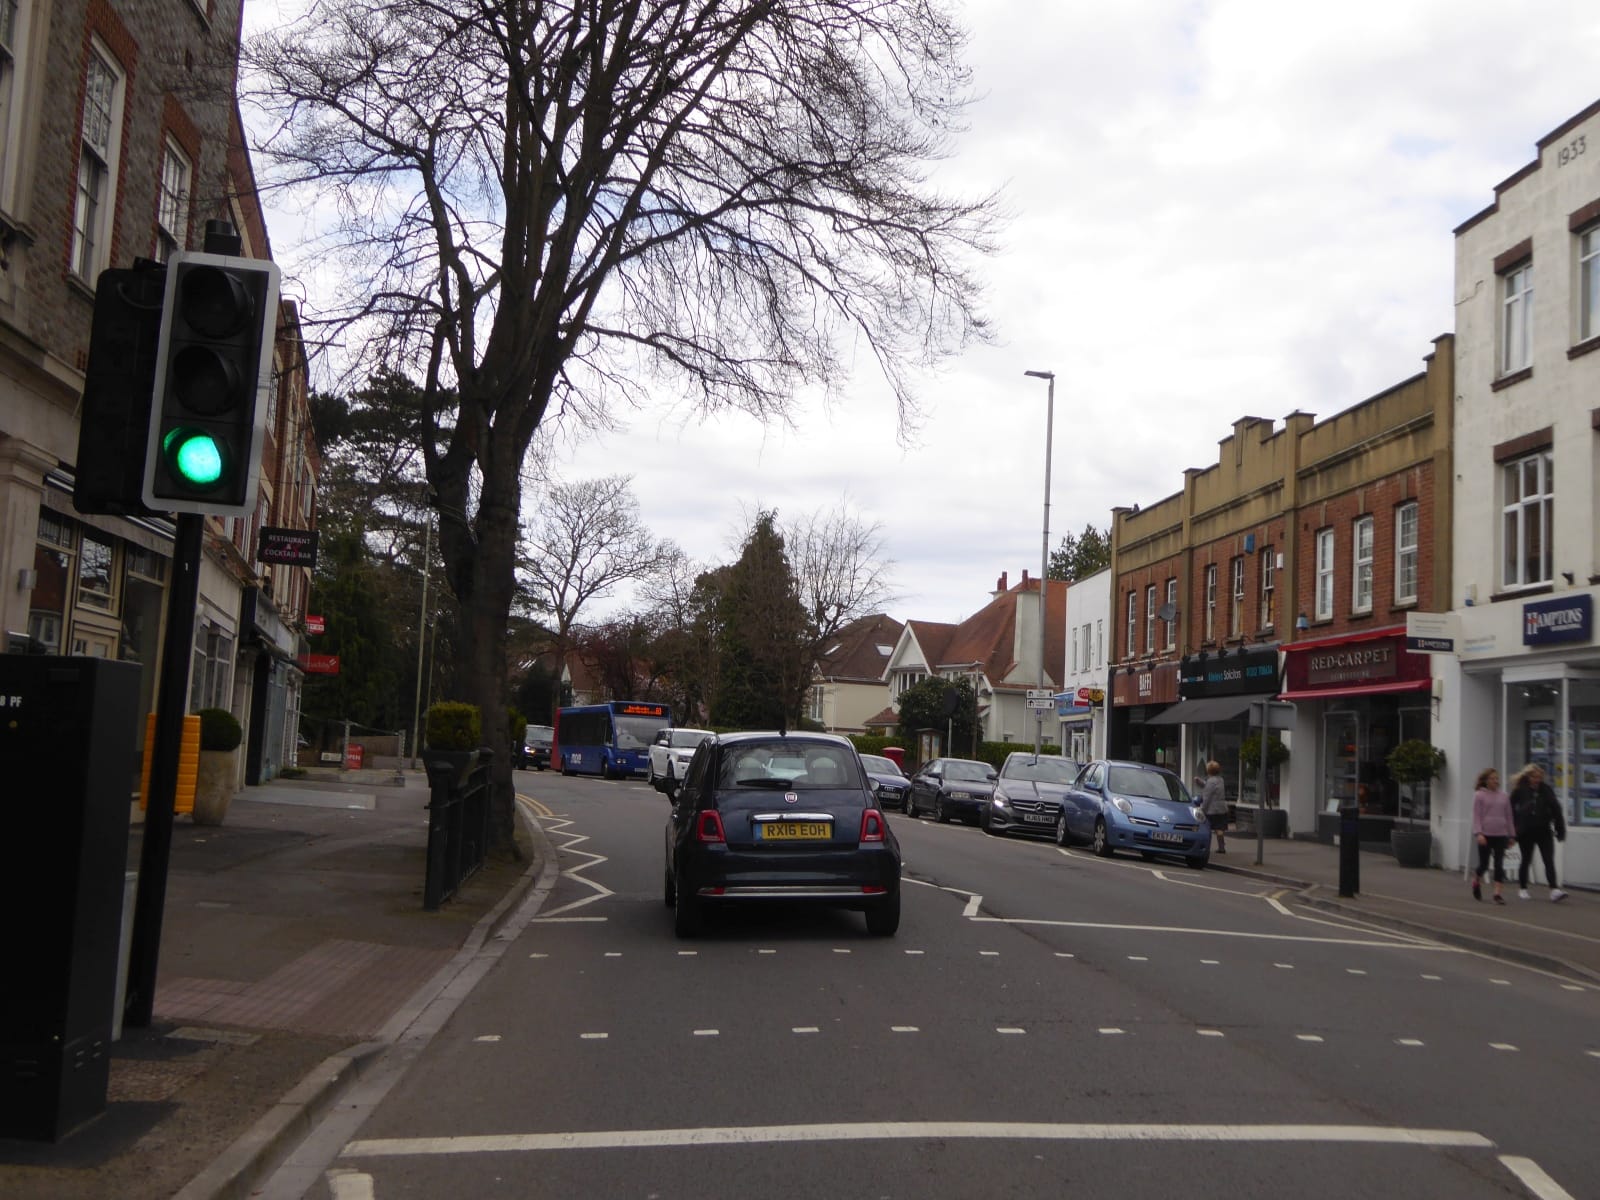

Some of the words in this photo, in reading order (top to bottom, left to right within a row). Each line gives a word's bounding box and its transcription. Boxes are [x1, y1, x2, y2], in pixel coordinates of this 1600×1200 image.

[1557, 135, 1587, 169] 1933
[268, 534, 311, 545] RESTAURANT
[264, 548, 297, 559] COCKTAIL
[298, 551, 312, 560] BAR
[1527, 607, 1584, 635] HAMPTONS
[10, 695, 23, 708] PF
[767, 824, 797, 837] RX16
[800, 824, 827, 837] EOH
